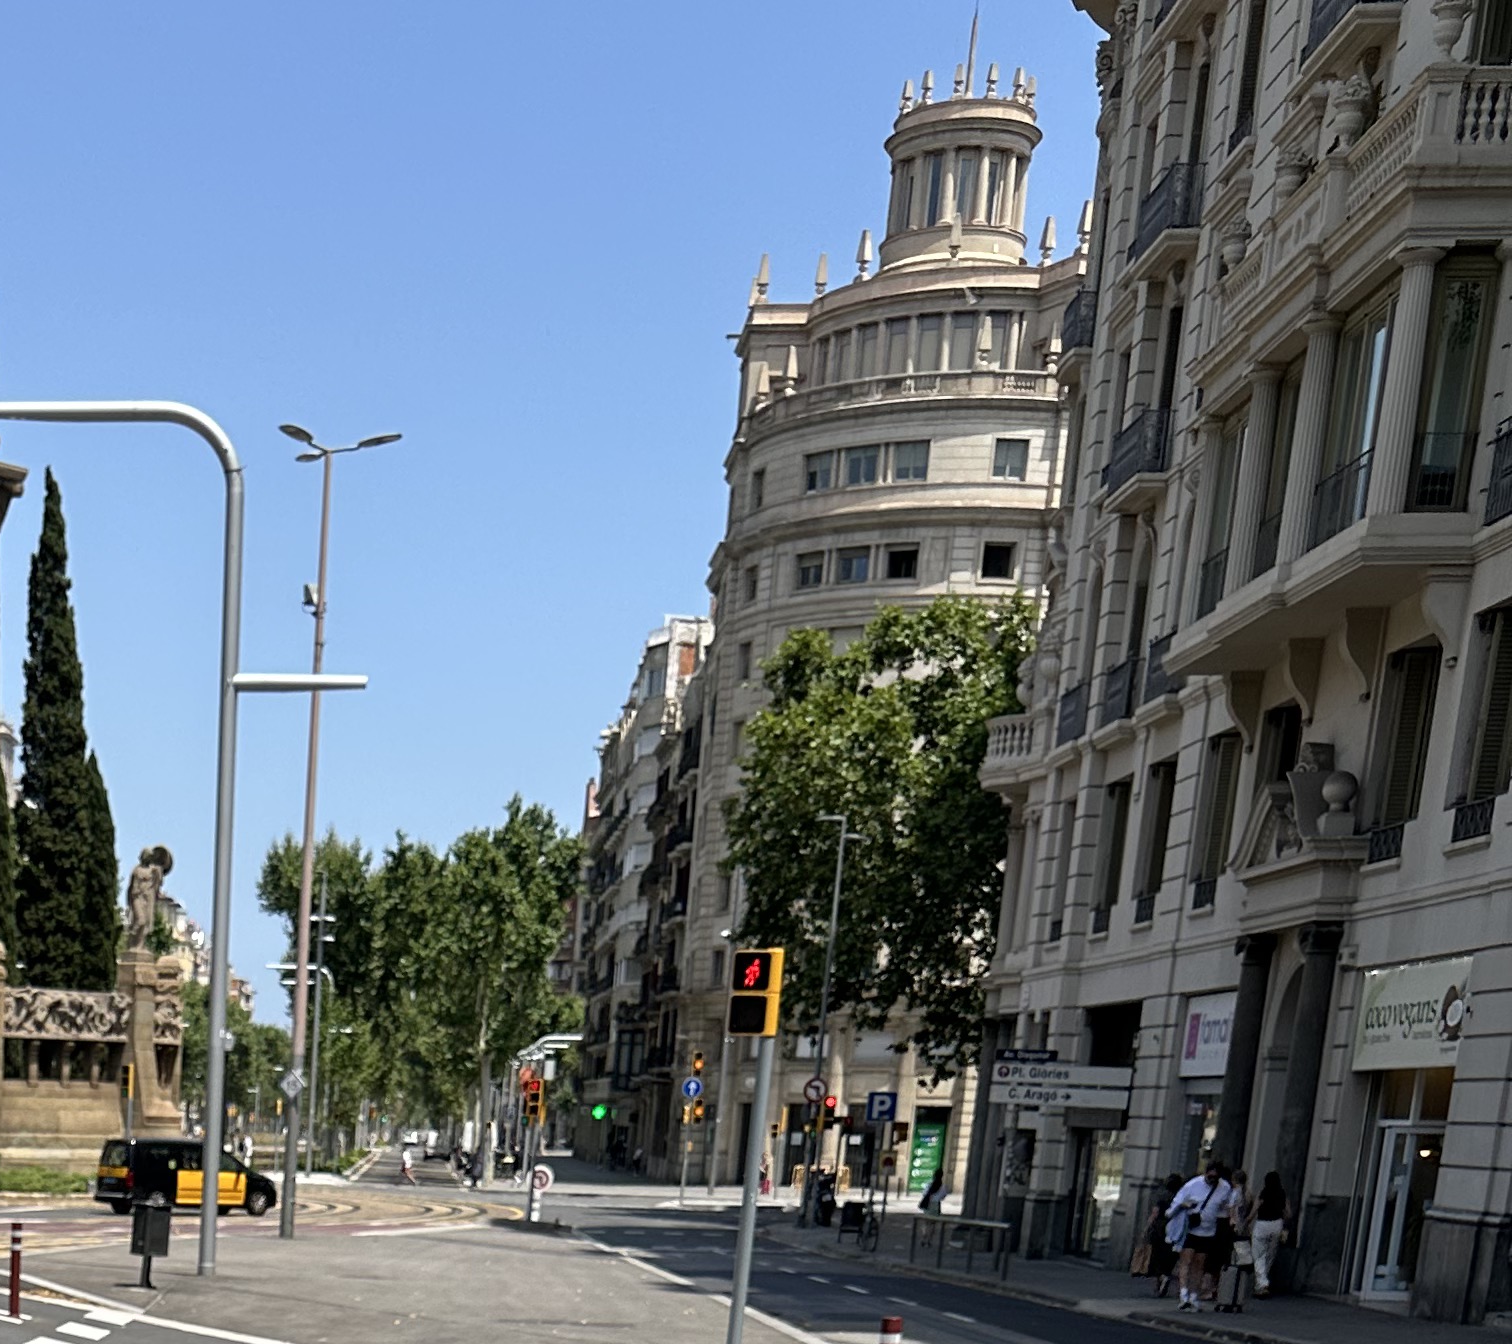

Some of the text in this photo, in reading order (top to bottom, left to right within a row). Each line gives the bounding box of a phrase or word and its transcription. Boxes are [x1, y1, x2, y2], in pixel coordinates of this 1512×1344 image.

[1011, 1067, 1070, 1079] Pl. Glòries
[1008, 1088, 1058, 1103] C. Aragó
[871, 1094, 891, 1119] P
